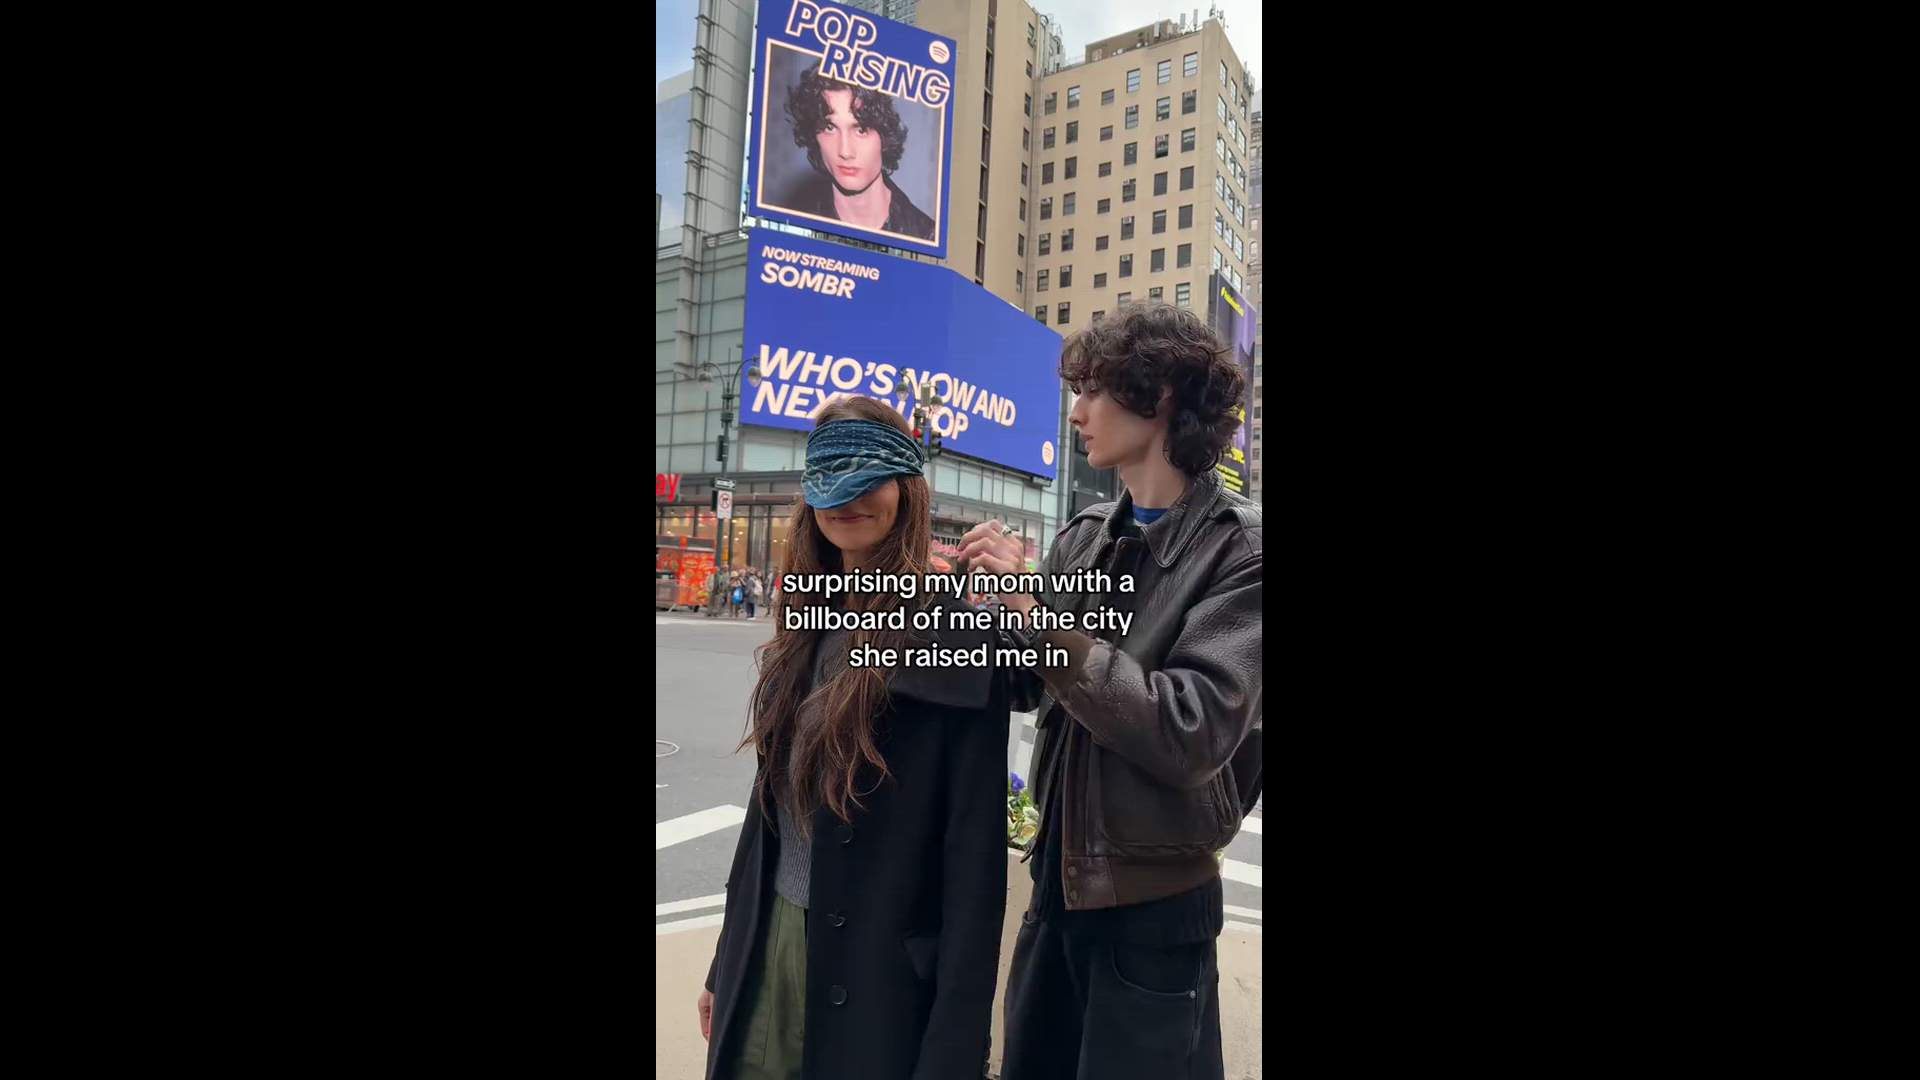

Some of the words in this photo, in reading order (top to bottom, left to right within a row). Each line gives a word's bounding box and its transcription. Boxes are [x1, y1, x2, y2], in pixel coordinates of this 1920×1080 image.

[785, 0, 877, 49] POP
[818, 40, 950, 107] RISING
[760, 261, 856, 299] SOMBR
[761, 245, 802, 264] NOW
[800, 253, 881, 281] STREAMING
[901, 367, 977, 411] NOW
[972, 384, 1017, 427] AND
